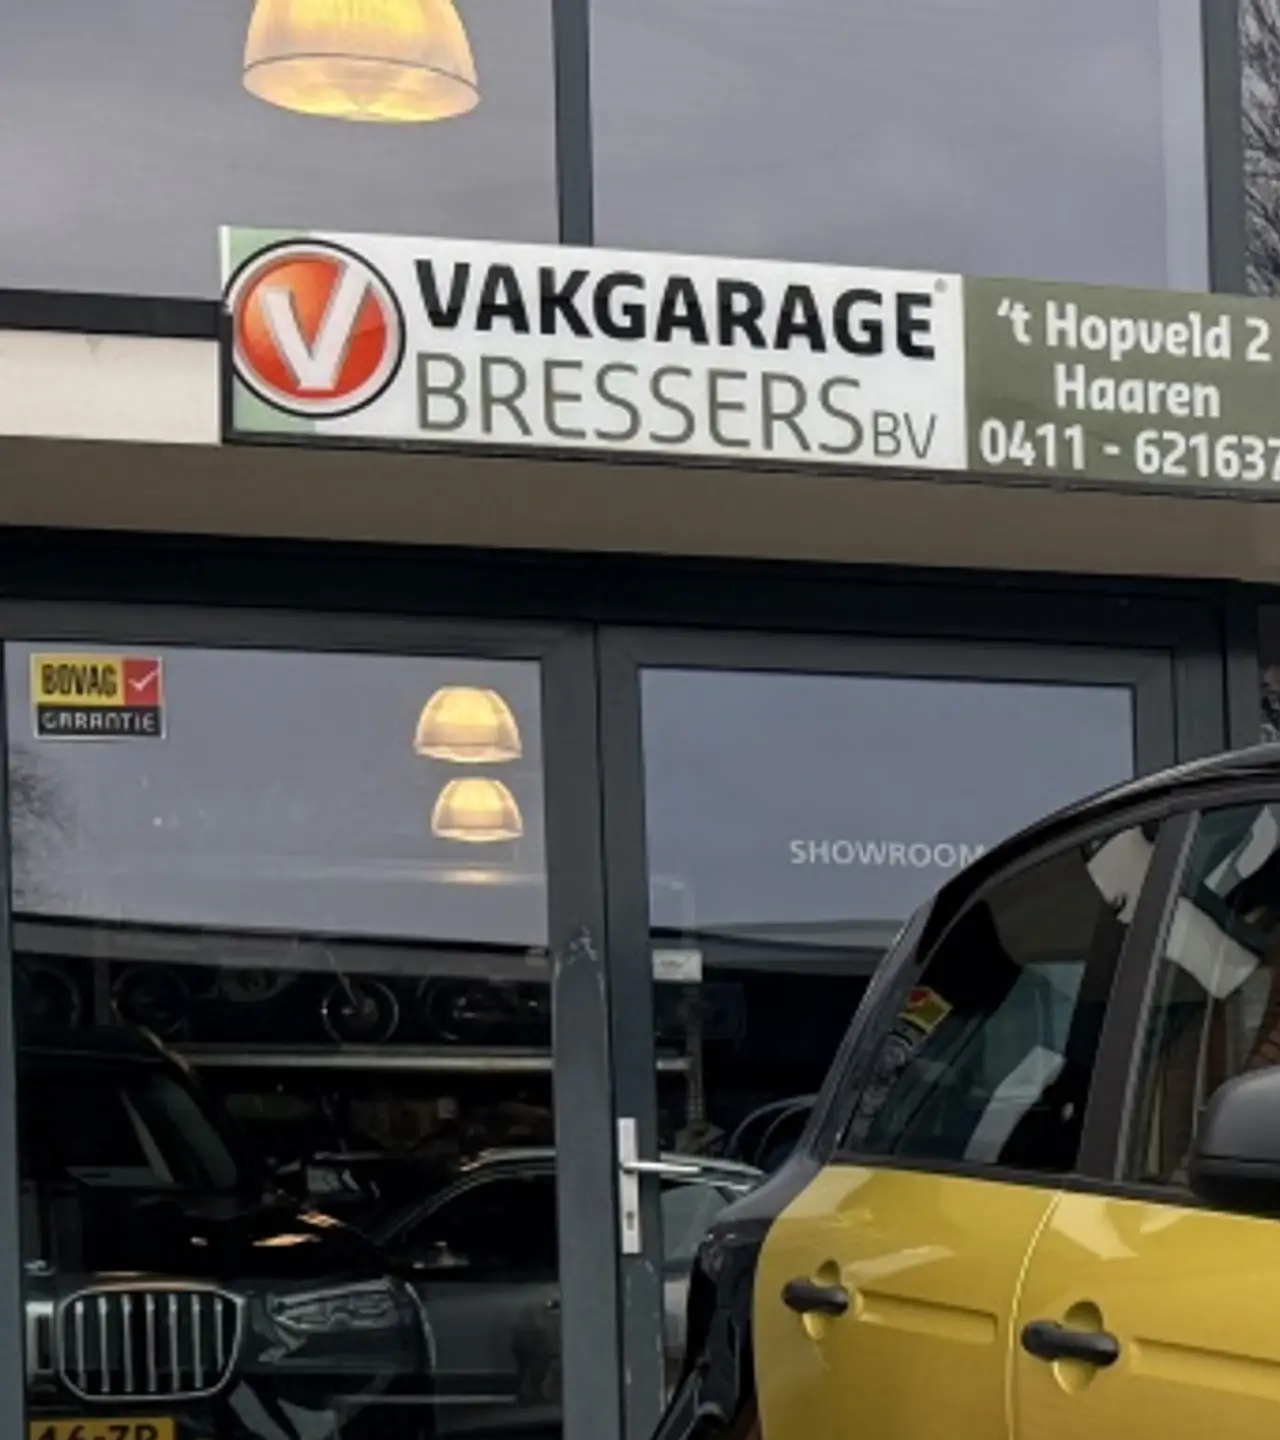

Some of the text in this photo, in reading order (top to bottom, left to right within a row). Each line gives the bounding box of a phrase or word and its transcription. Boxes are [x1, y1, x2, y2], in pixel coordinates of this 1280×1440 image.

[415, 257, 936, 361] VAKGARAGE
[1045, 300, 1230, 360] Hopveld
[1245, 318, 1272, 361] 2
[415, 351, 937, 460] BRESSERS BV
[1054, 363, 1219, 418] Haaren
[980, 418, 1085, 470] 0411
[41, 663, 117, 697] BOVAG
[41, 711, 156, 732] GARANTIE
